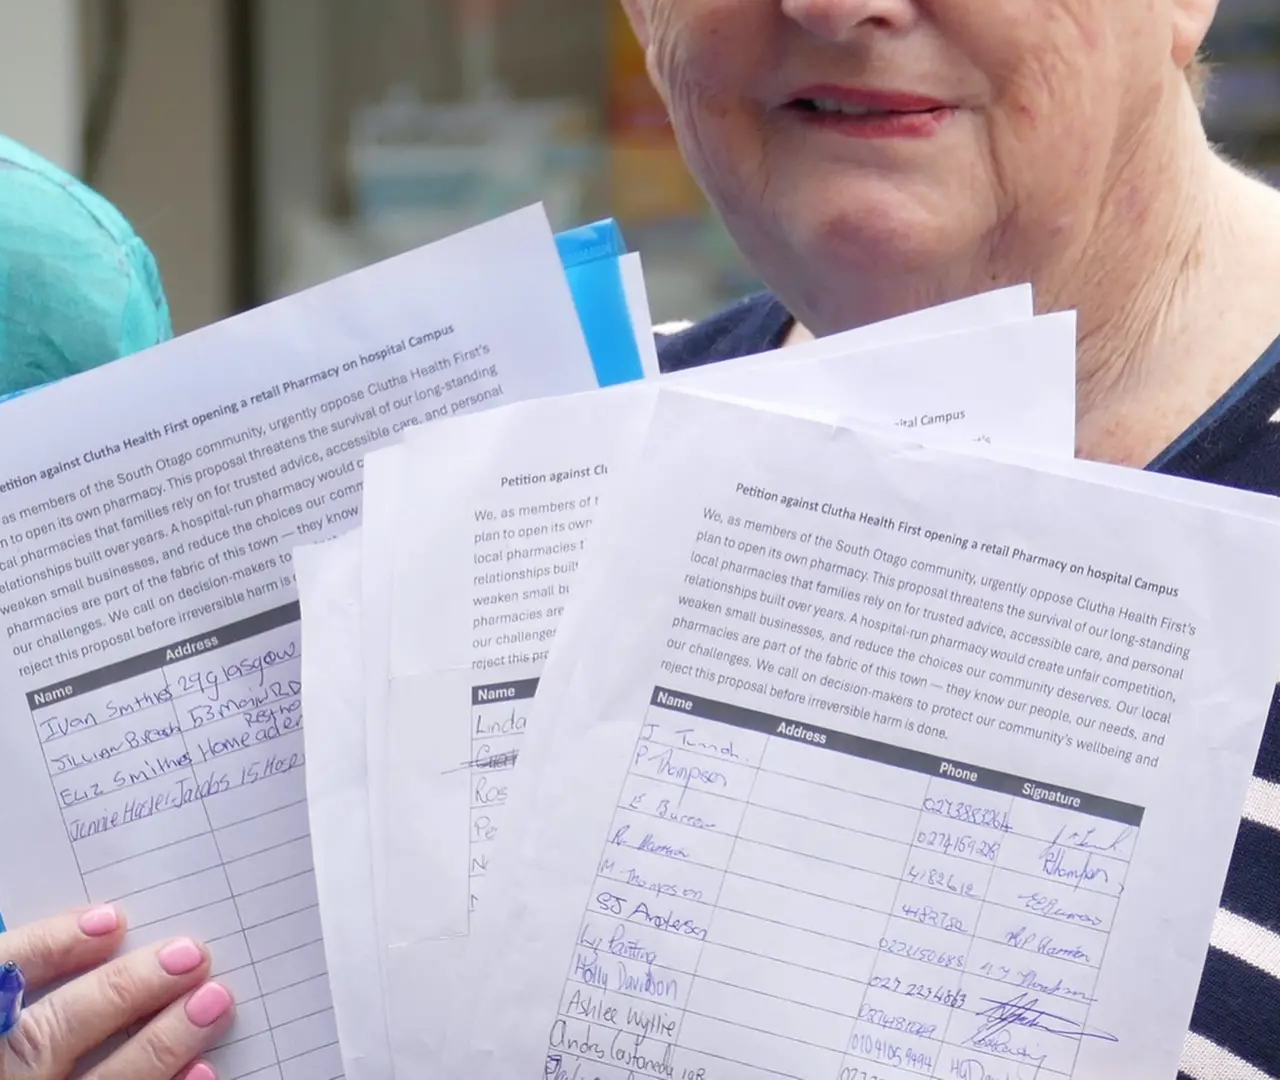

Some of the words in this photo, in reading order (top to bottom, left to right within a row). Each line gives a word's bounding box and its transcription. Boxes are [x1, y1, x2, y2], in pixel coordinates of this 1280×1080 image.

[1, 512, 17, 525] as
[18, 491, 77, 519] members
[79, 484, 92, 498] of
[93, 478, 115, 492] the
[116, 464, 154, 485] South
[155, 451, 193, 471] Otago
[195, 425, 266, 457] community,
[268, 406, 317, 431] urgently
[319, 389, 365, 413] oppose
[366, 374, 408, 395] Clutha
[409, 357, 451, 380] Health
[452, 344, 490, 364] First's
[39, 456, 81, 479] against
[82, 444, 121, 463] Clutha
[122, 428, 162, 449] Health
[163, 418, 189, 435] First
[191, 402, 239, 425] opening
[239, 398, 248, 408] a
[249, 384, 281, 405] retail
[281, 365, 339, 393] Pharmacy
[341, 359, 358, 371] on
[358, 339, 406, 365] hospital
[407, 324, 455, 348] Campus
[920, 410, 966, 427] Campus
[473, 509, 496, 522] We,
[500, 508, 515, 518] as
[518, 500, 575, 516] members
[578, 495, 591, 508] of
[500, 473, 546, 487] Petition
[549, 466, 590, 483] against
[473, 531, 500, 545] plan
[502, 529, 515, 539] to
[517, 524, 548, 538] open
[550, 522, 565, 532] its
[703, 507, 723, 524] We,
[726, 515, 741, 527] as
[743, 519, 797, 540] members
[799, 532, 812, 543] of
[814, 535, 833, 549] the
[835, 539, 870, 557] South
[872, 548, 907, 568] Otago
[909, 559, 976, 585] community,
[980, 576, 1028, 598] urgently
[1029, 587, 1073, 606] oppose
[1075, 596, 1115, 616] Clutha
[1117, 606, 1157, 627] Health
[1159, 616, 1196, 636] First's
[735, 482, 778, 502] Petition
[779, 495, 819, 512] against
[820, 502, 856, 520] Clutha
[858, 511, 895, 530] Health
[897, 520, 922, 536] First
[923, 529, 969, 550] opening
[970, 540, 978, 549] a
[979, 542, 1010, 557] retail
[1011, 547, 1068, 573] Pharmacy
[1069, 564, 1084, 575] on
[1086, 564, 1133, 586] hospital
[1133, 576, 1178, 597] Campus
[690, 550, 719, 568] local
[719, 559, 788, 584] pharmacies
[789, 575, 813, 591] that
[815, 580, 861, 602] families
[862, 594, 885, 610] rely
[886, 600, 902, 612] on
[903, 601, 920, 616] for
[922, 607, 965, 628] trusted
[965, 619, 1006, 639] advice,
[1009, 629, 1072, 653] accessible
[1074, 645, 1103, 662] care,
[1105, 653, 1130, 667] and
[1130, 659, 1184, 680] personal
[695, 530, 722, 545] plan
[723, 535, 736, 548] to
[737, 541, 766, 556] open
[767, 548, 782, 559] its
[783, 552, 808, 565] own
[808, 557, 868, 583] pharmacy.
[872, 570, 896, 587] This
[896, 579, 948, 600] proposal
[949, 590, 1004, 613] threatens
[1005, 604, 1025, 618] the
[1026, 610, 1073, 629] survival
[1073, 621, 1087, 632] of
[1087, 625, 1108, 638] our
[1109, 627, 1190, 661] long-standing
[34, 683, 74, 706] Name
[165, 635, 219, 662] Address
[478, 686, 516, 701] Name
[476, 708, 527, 734] Linda
[656, 692, 694, 711] Name
[776, 721, 827, 745] Address
[939, 762, 978, 783] Phone
[1022, 782, 1081, 808] Signature
